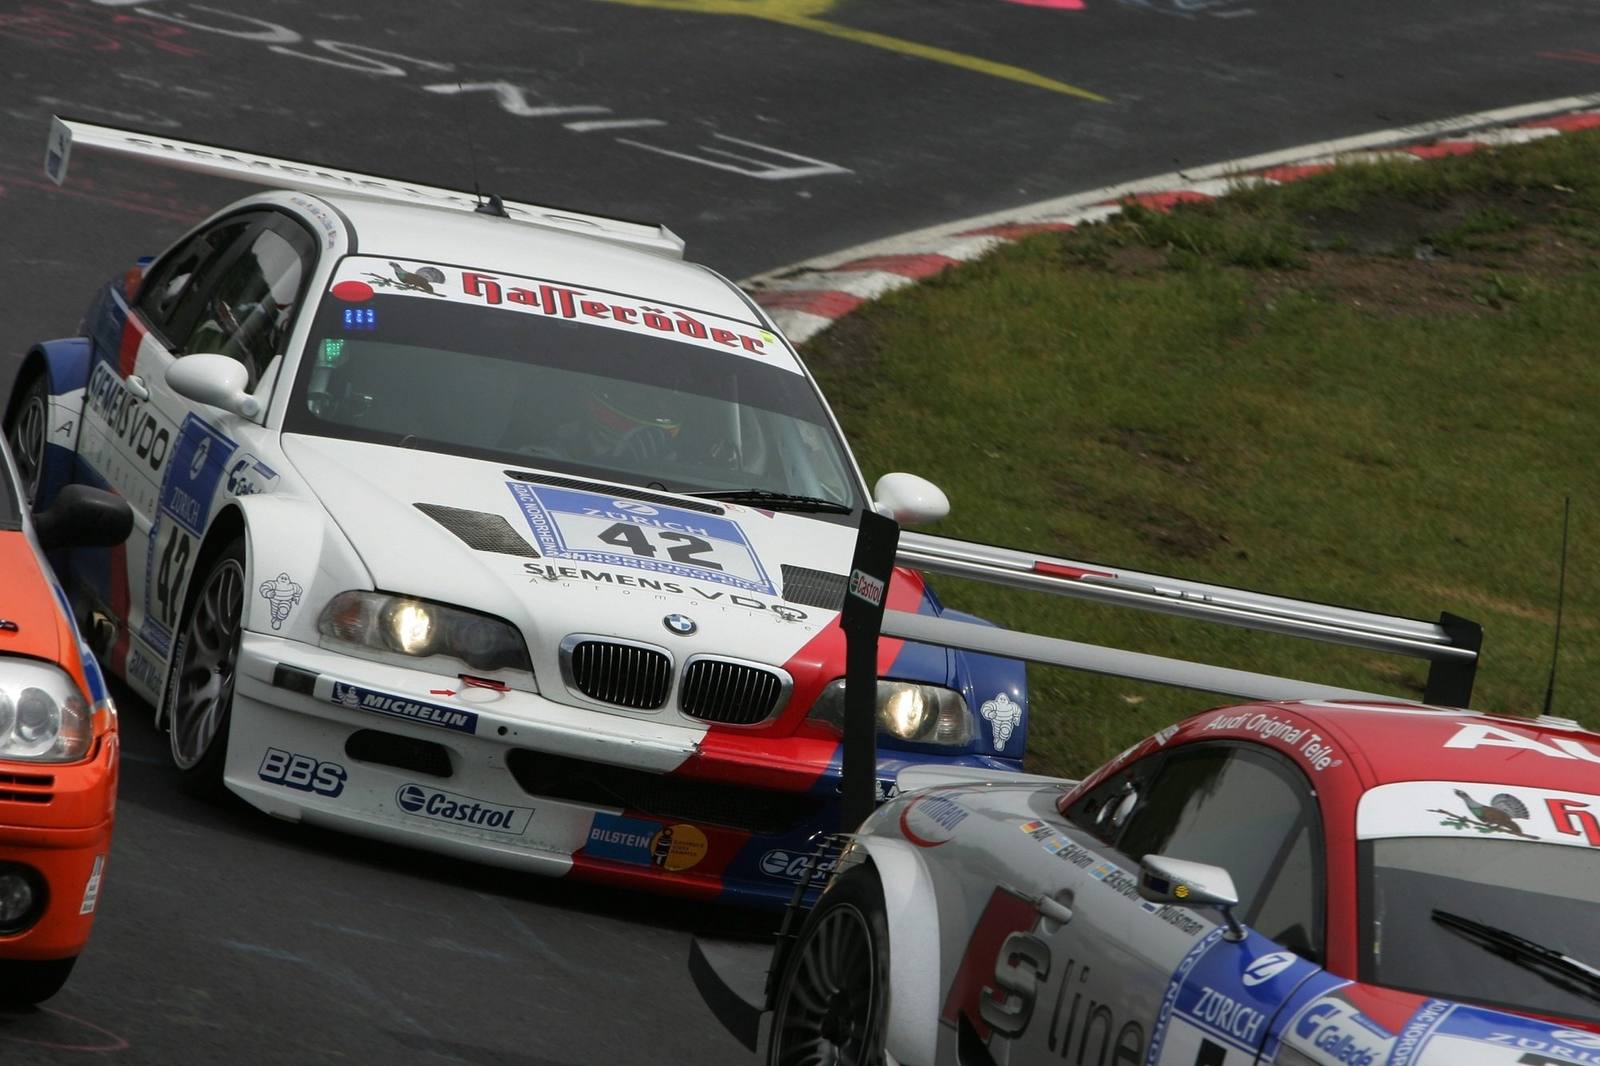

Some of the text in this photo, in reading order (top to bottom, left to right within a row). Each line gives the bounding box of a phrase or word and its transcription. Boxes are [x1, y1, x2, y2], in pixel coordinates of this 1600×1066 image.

[597, 522, 724, 571] 42
[157, 525, 190, 629] 42
[523, 563, 808, 621] SIEMENS VDO
[857, 575, 883, 603] Castrol
[363, 693, 468, 727] MICHELIN
[1202, 713, 1252, 731] Audi
[1247, 713, 1311, 745] Original
[258, 747, 347, 798] BBS
[426, 793, 515, 829] Castrol
[590, 828, 650, 848] BILSTEIN
[1154, 904, 1204, 937] Huisman
[1048, 958, 1145, 1066] line
